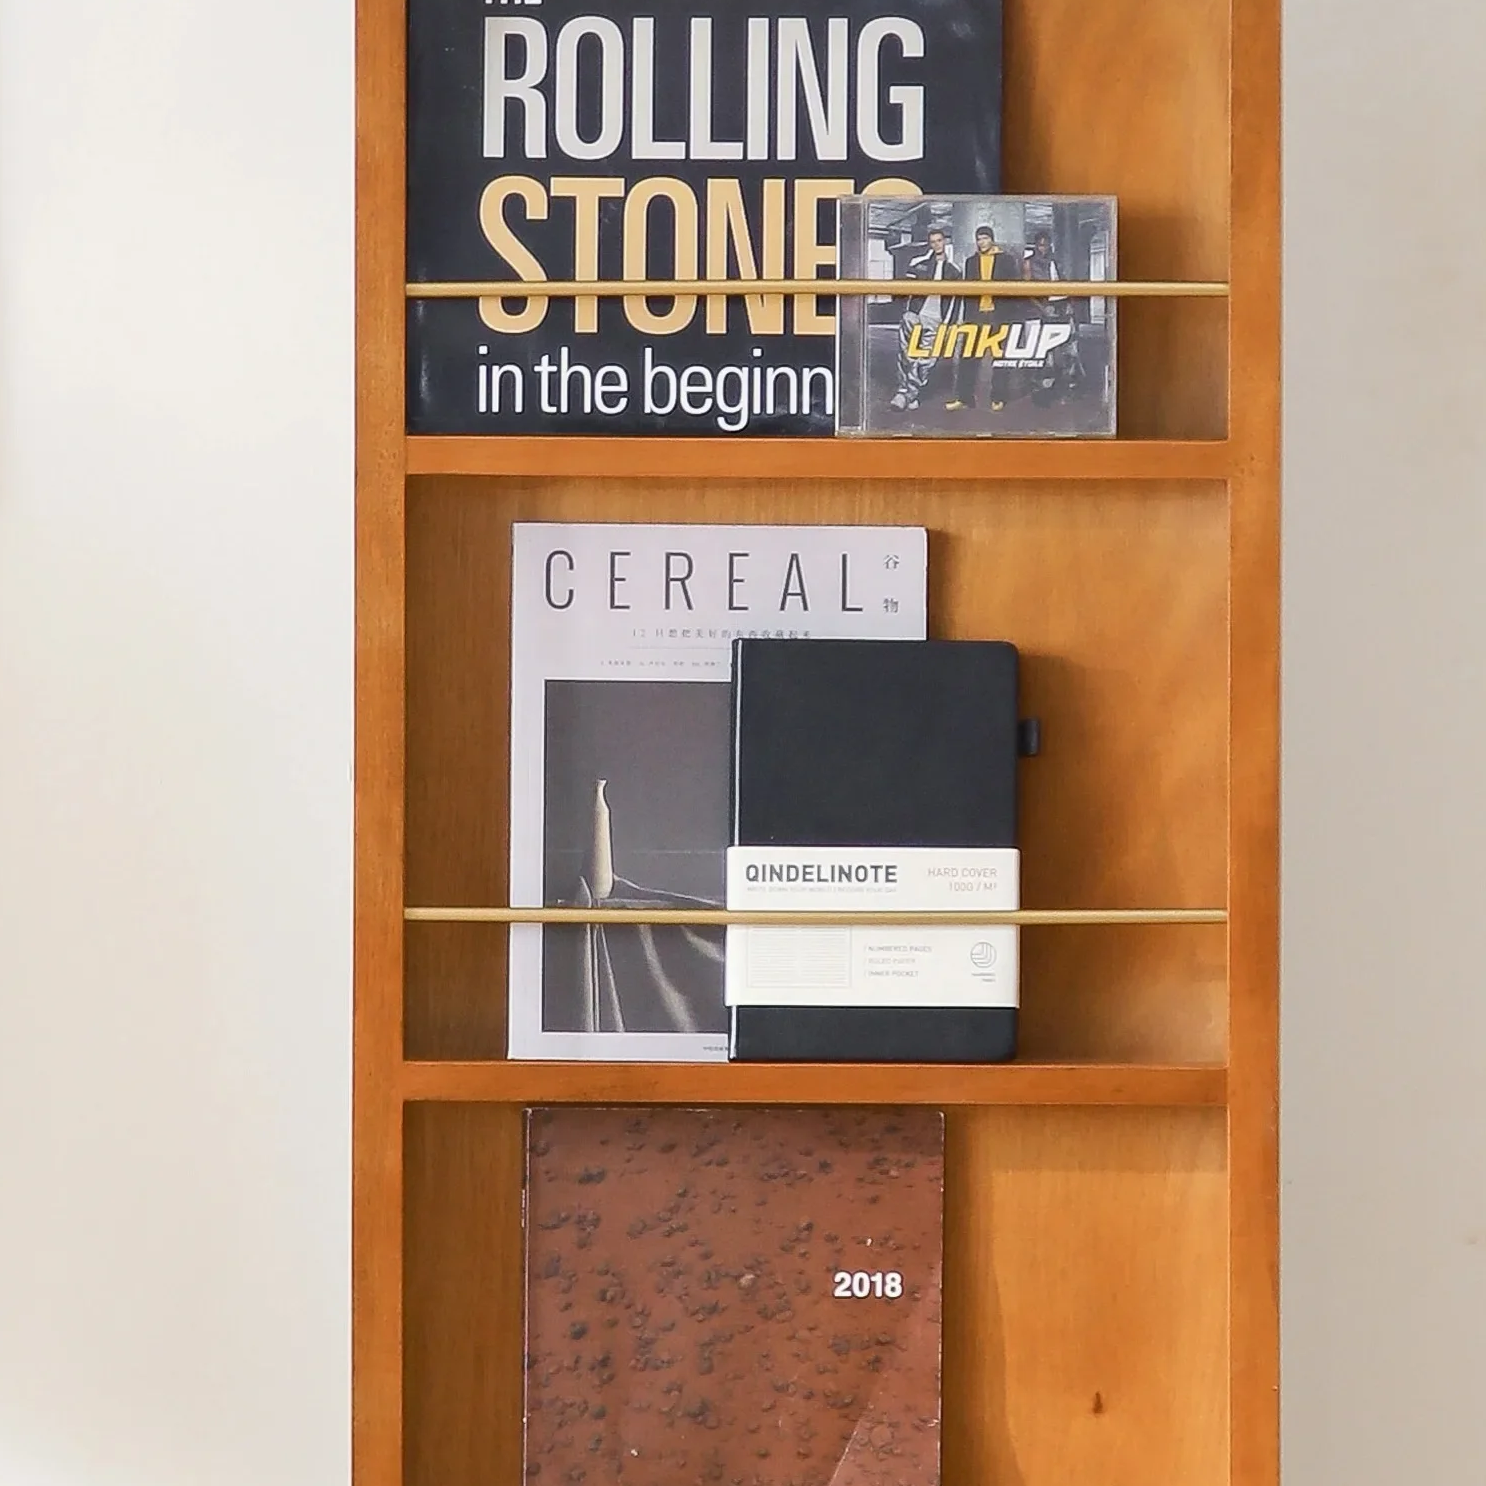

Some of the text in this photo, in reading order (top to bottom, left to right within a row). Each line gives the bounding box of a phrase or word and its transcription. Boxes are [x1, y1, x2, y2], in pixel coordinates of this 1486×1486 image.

[481, 16, 925, 162] ROLLING
[477, 176, 923, 337] STONE
[478, 346, 834, 431] in the beginn
[543, 549, 864, 613] CEREAL
[745, 864, 898, 883] QINDELINOTE
[927, 867, 998, 878] HARD COVER
[833, 1271, 903, 1297] 2018
